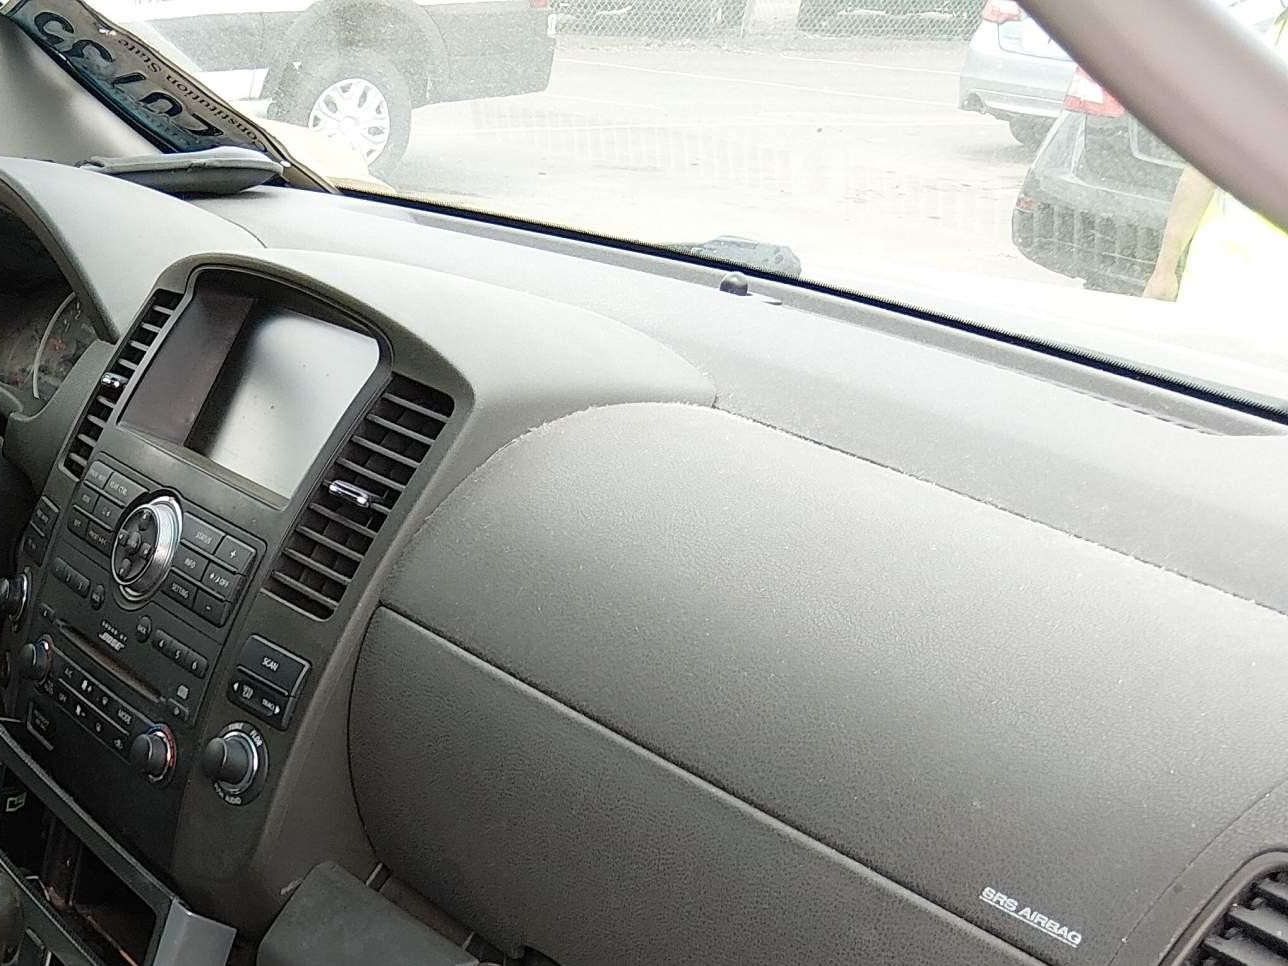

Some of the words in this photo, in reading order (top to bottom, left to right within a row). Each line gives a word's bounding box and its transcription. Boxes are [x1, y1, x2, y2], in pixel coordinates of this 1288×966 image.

[118, 38, 162, 74] State
[262, 656, 279, 672] SCAN
[982, 887, 1018, 911] SRS
[1018, 907, 1082, 945] AIRBAG
